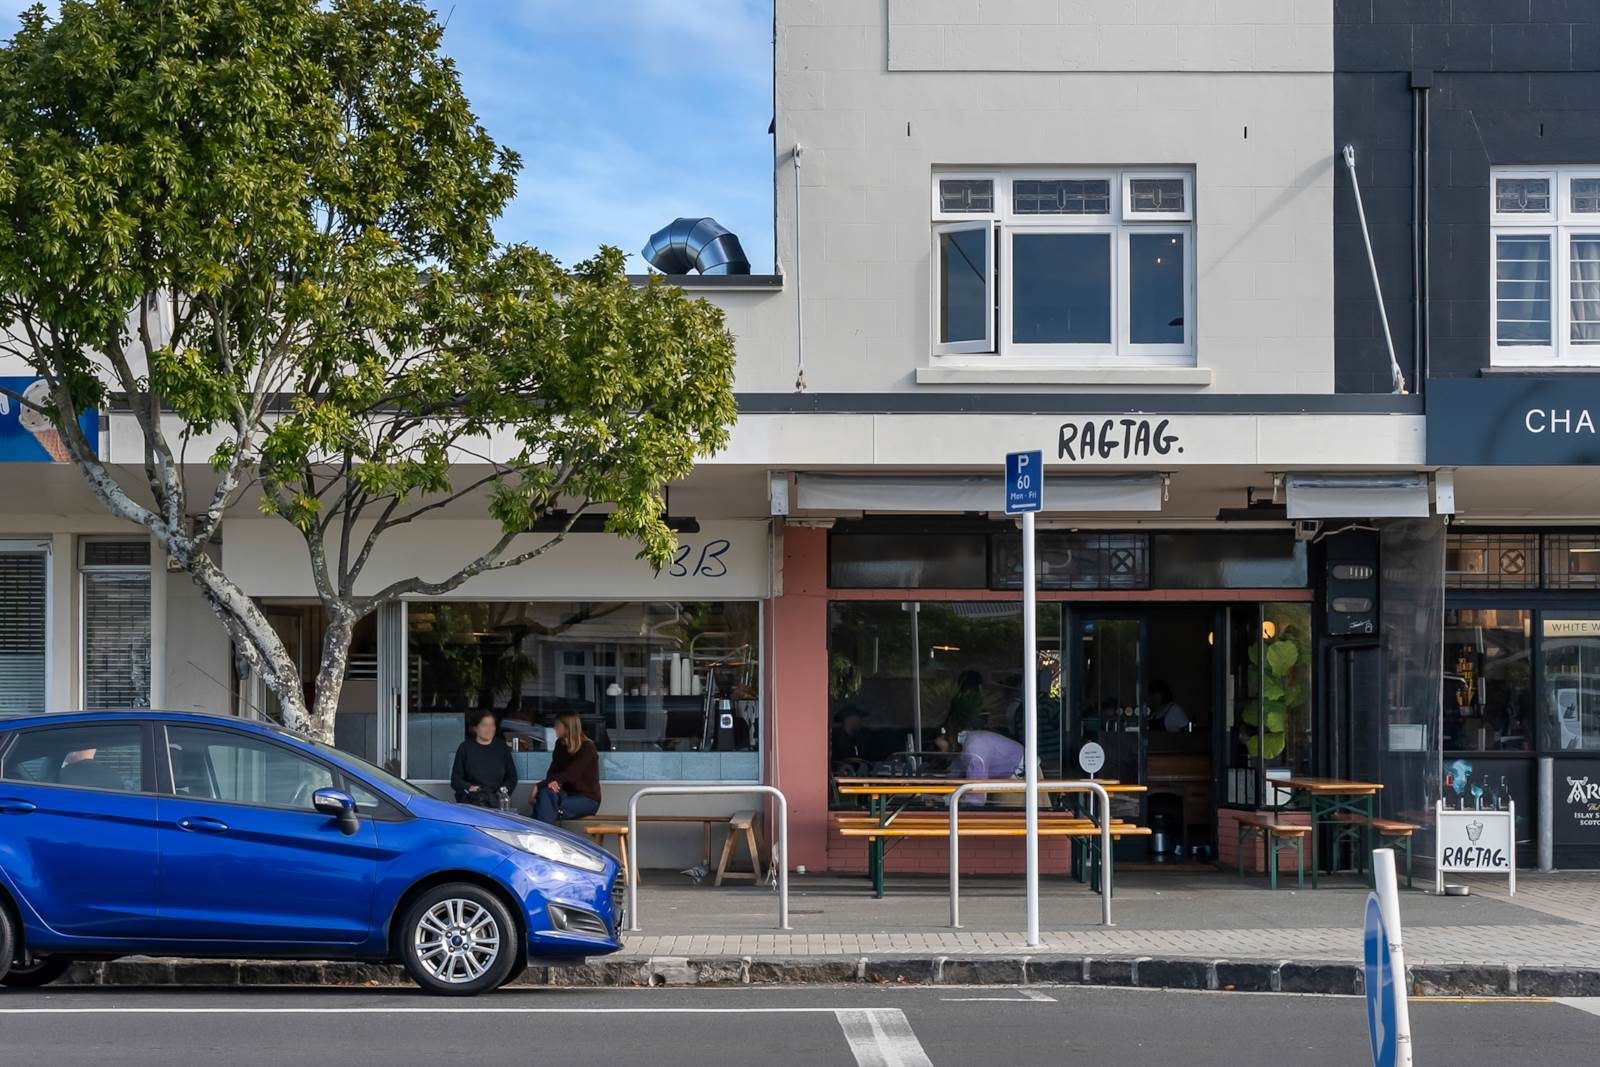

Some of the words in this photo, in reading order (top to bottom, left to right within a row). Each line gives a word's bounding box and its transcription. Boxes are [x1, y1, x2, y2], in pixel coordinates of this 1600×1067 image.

[1525, 408, 1596, 434] CHA
[1058, 419, 1184, 461] RAGTAG.
[1018, 455, 1029, 474] P
[1017, 475, 1030, 489] 60
[1010, 492, 1024, 500] Mon
[1028, 491, 1037, 499] Fri
[1551, 623, 1588, 632] WHITE
[1566, 776, 1600, 804] AR
[1442, 846, 1509, 868] RAGTAG.
